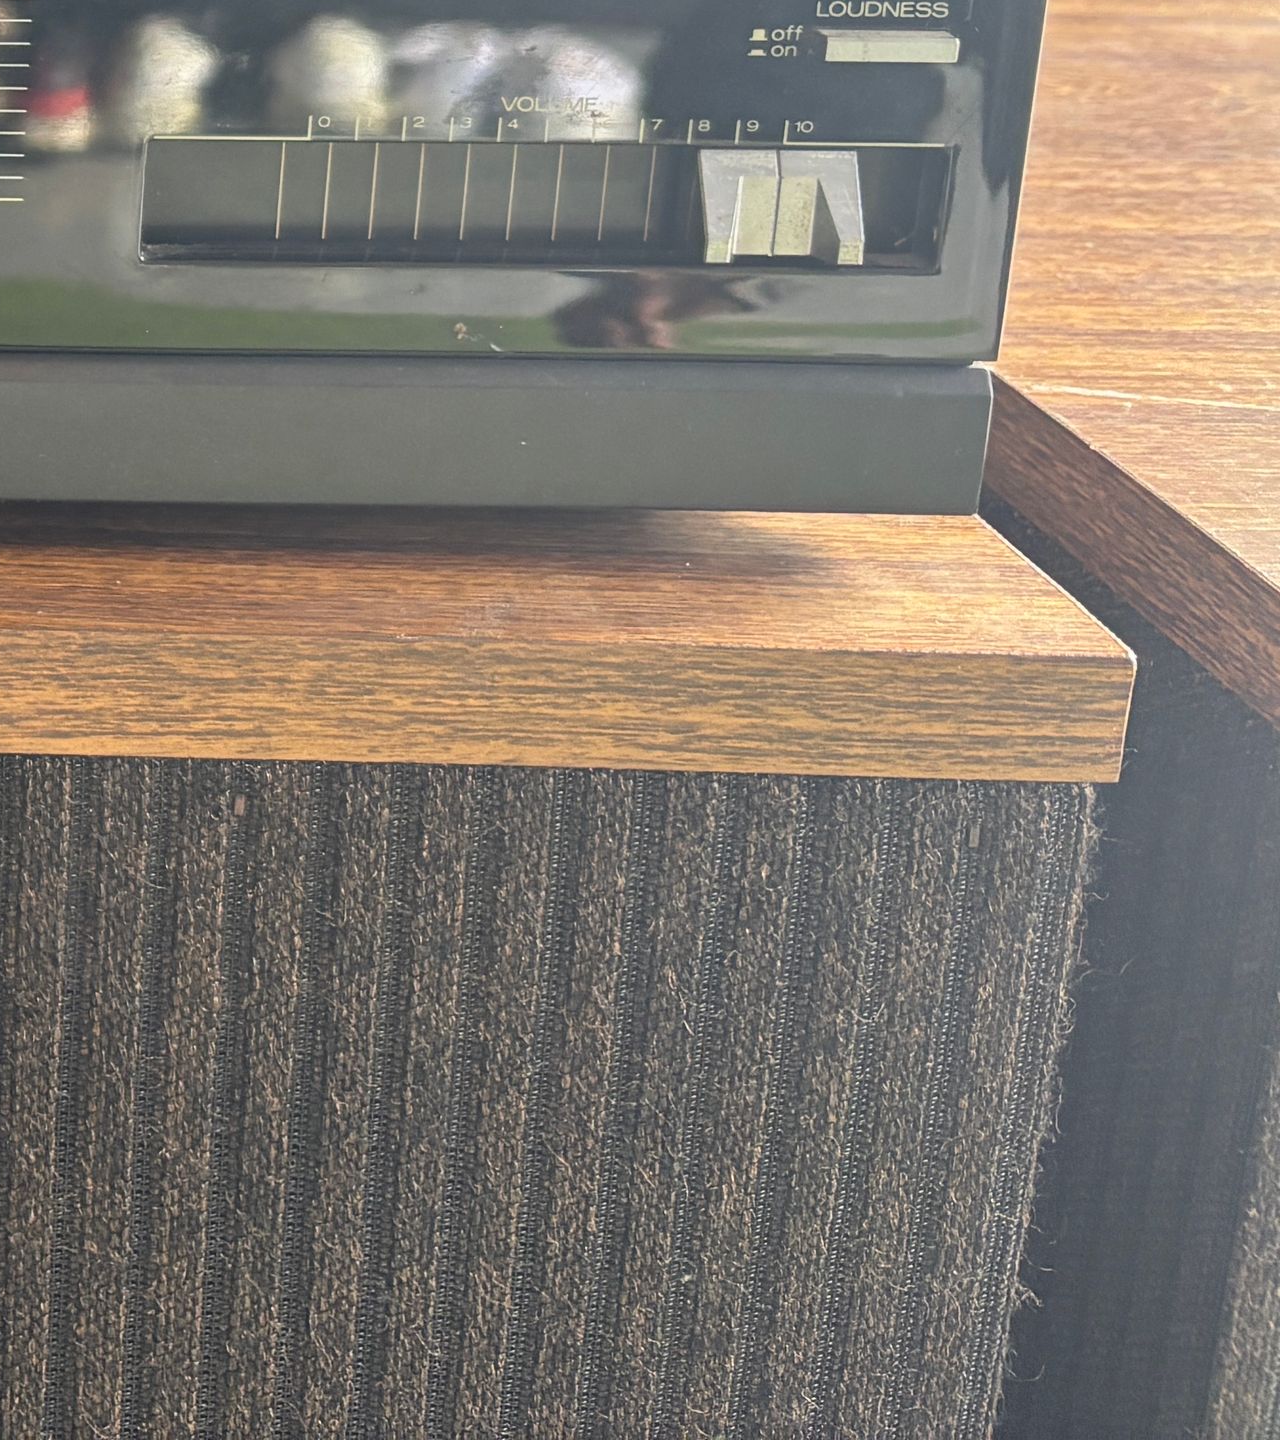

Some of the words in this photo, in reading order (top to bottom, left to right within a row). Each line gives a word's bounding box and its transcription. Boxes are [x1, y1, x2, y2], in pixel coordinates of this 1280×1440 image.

[816, 0, 949, 19] LOUDNESS
[771, 24, 804, 42] off
[770, 44, 797, 58] on
[500, 95, 599, 113] VOLME
[413, 116, 425, 129] 2
[459, 116, 473, 130] 3
[507, 118, 519, 129] 4
[651, 118, 664, 131] 7
[697, 119, 711, 132] 8
[746, 119, 760, 132] 9
[794, 120, 814, 134] 10
